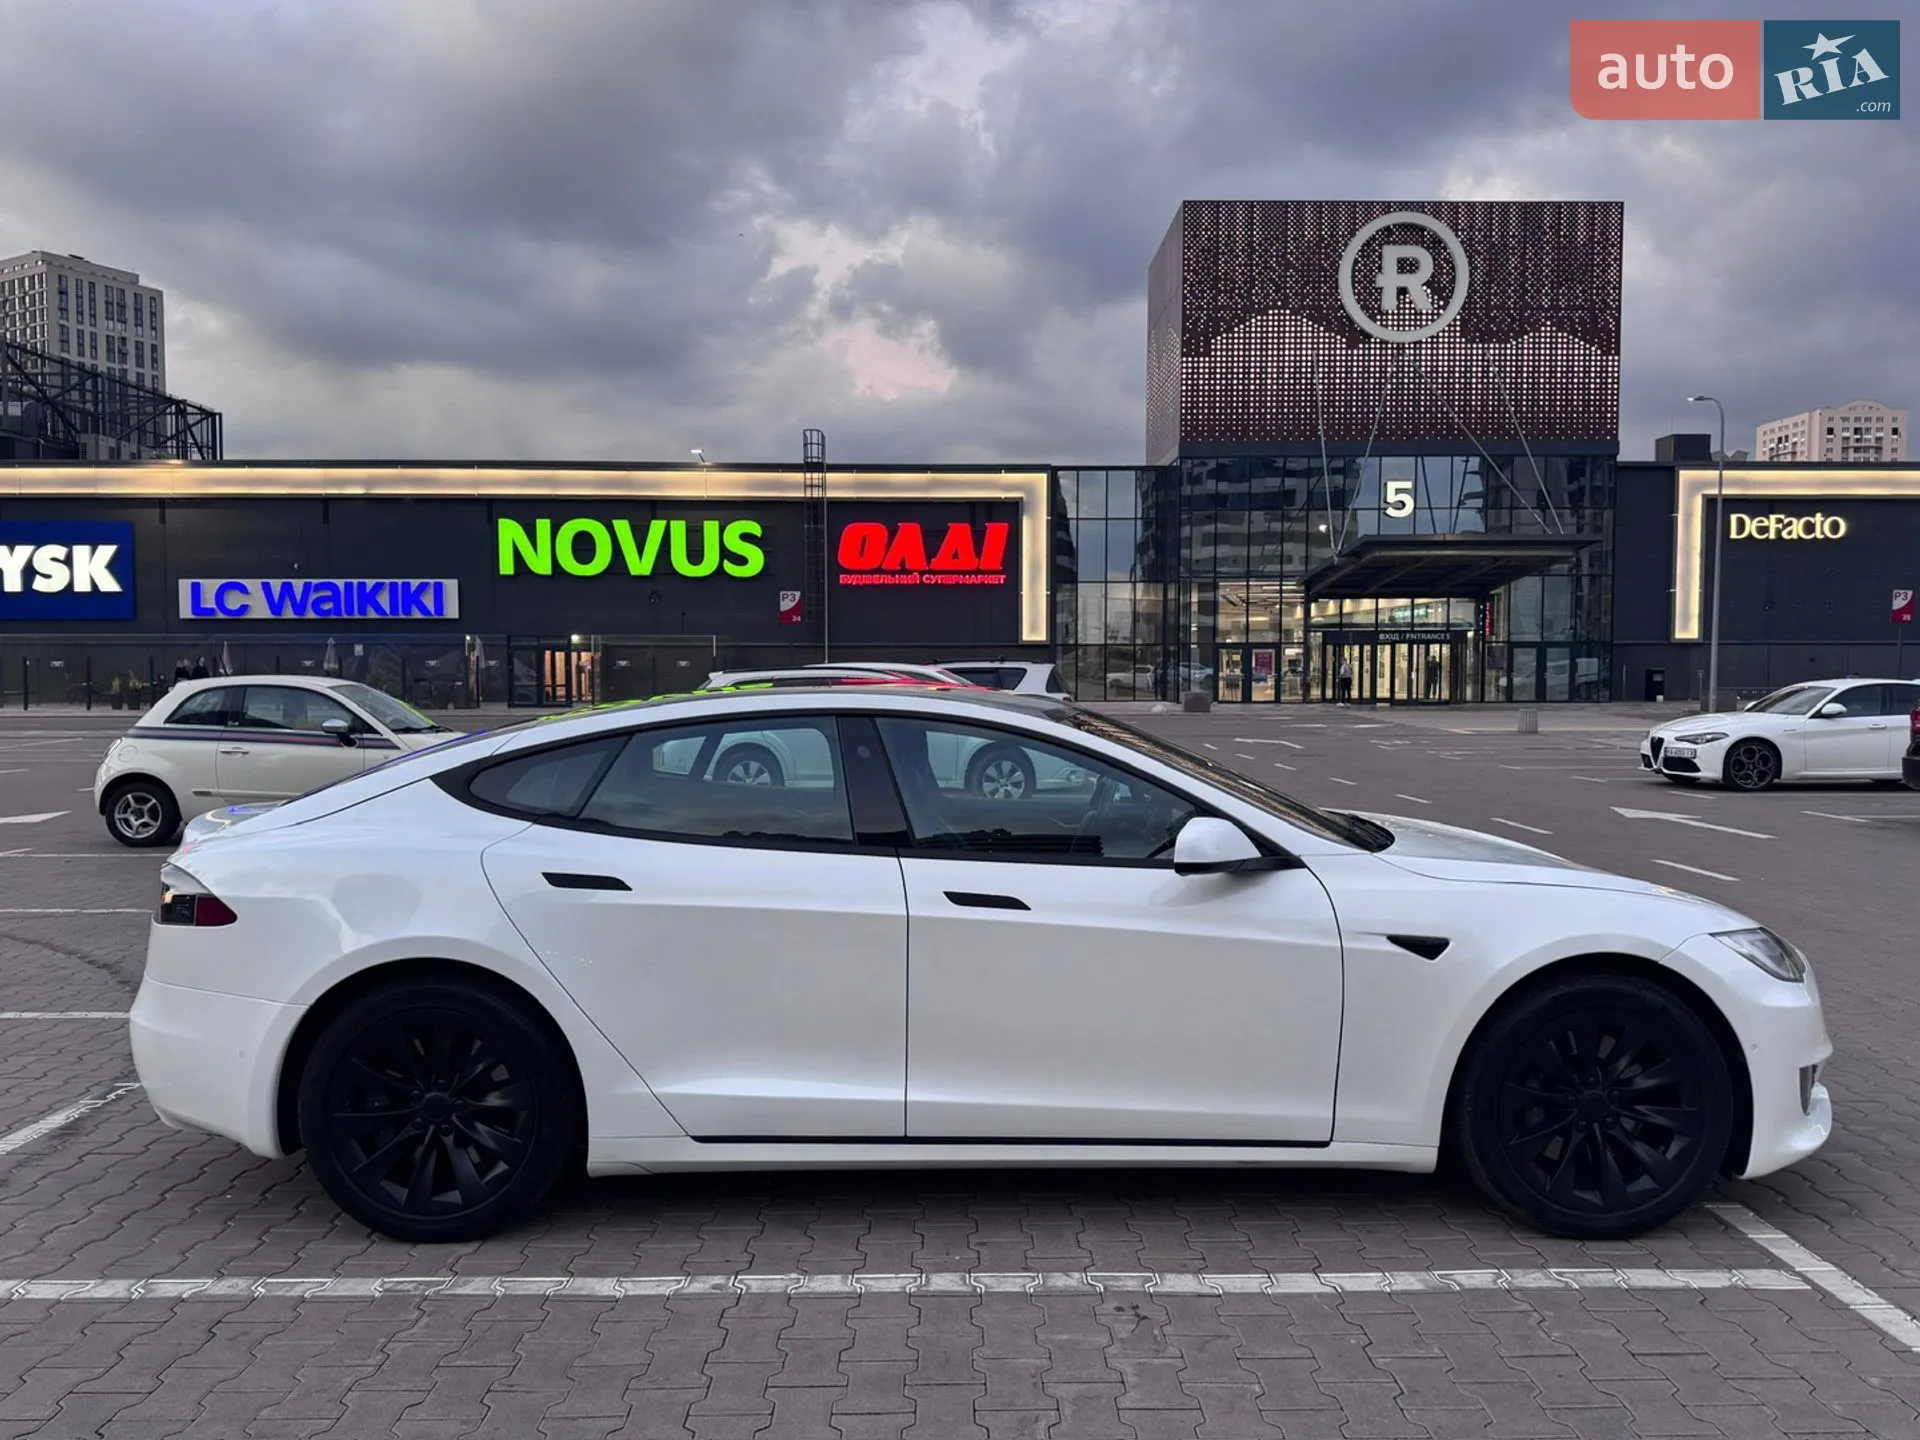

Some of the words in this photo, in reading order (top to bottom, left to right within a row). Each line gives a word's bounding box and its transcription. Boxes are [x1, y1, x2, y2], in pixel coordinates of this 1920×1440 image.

[1385, 481, 1415, 518] 5
[1729, 512, 1847, 540] DeFacto
[498, 518, 765, 578] NOVUS
[837, 522, 1009, 571] ОЛДІ
[922, 574, 1007, 585] СУПЕРМАРКЕТ
[190, 581, 251, 617] LC
[782, 593, 797, 602] P3
[1894, 591, 1909, 601] P3
